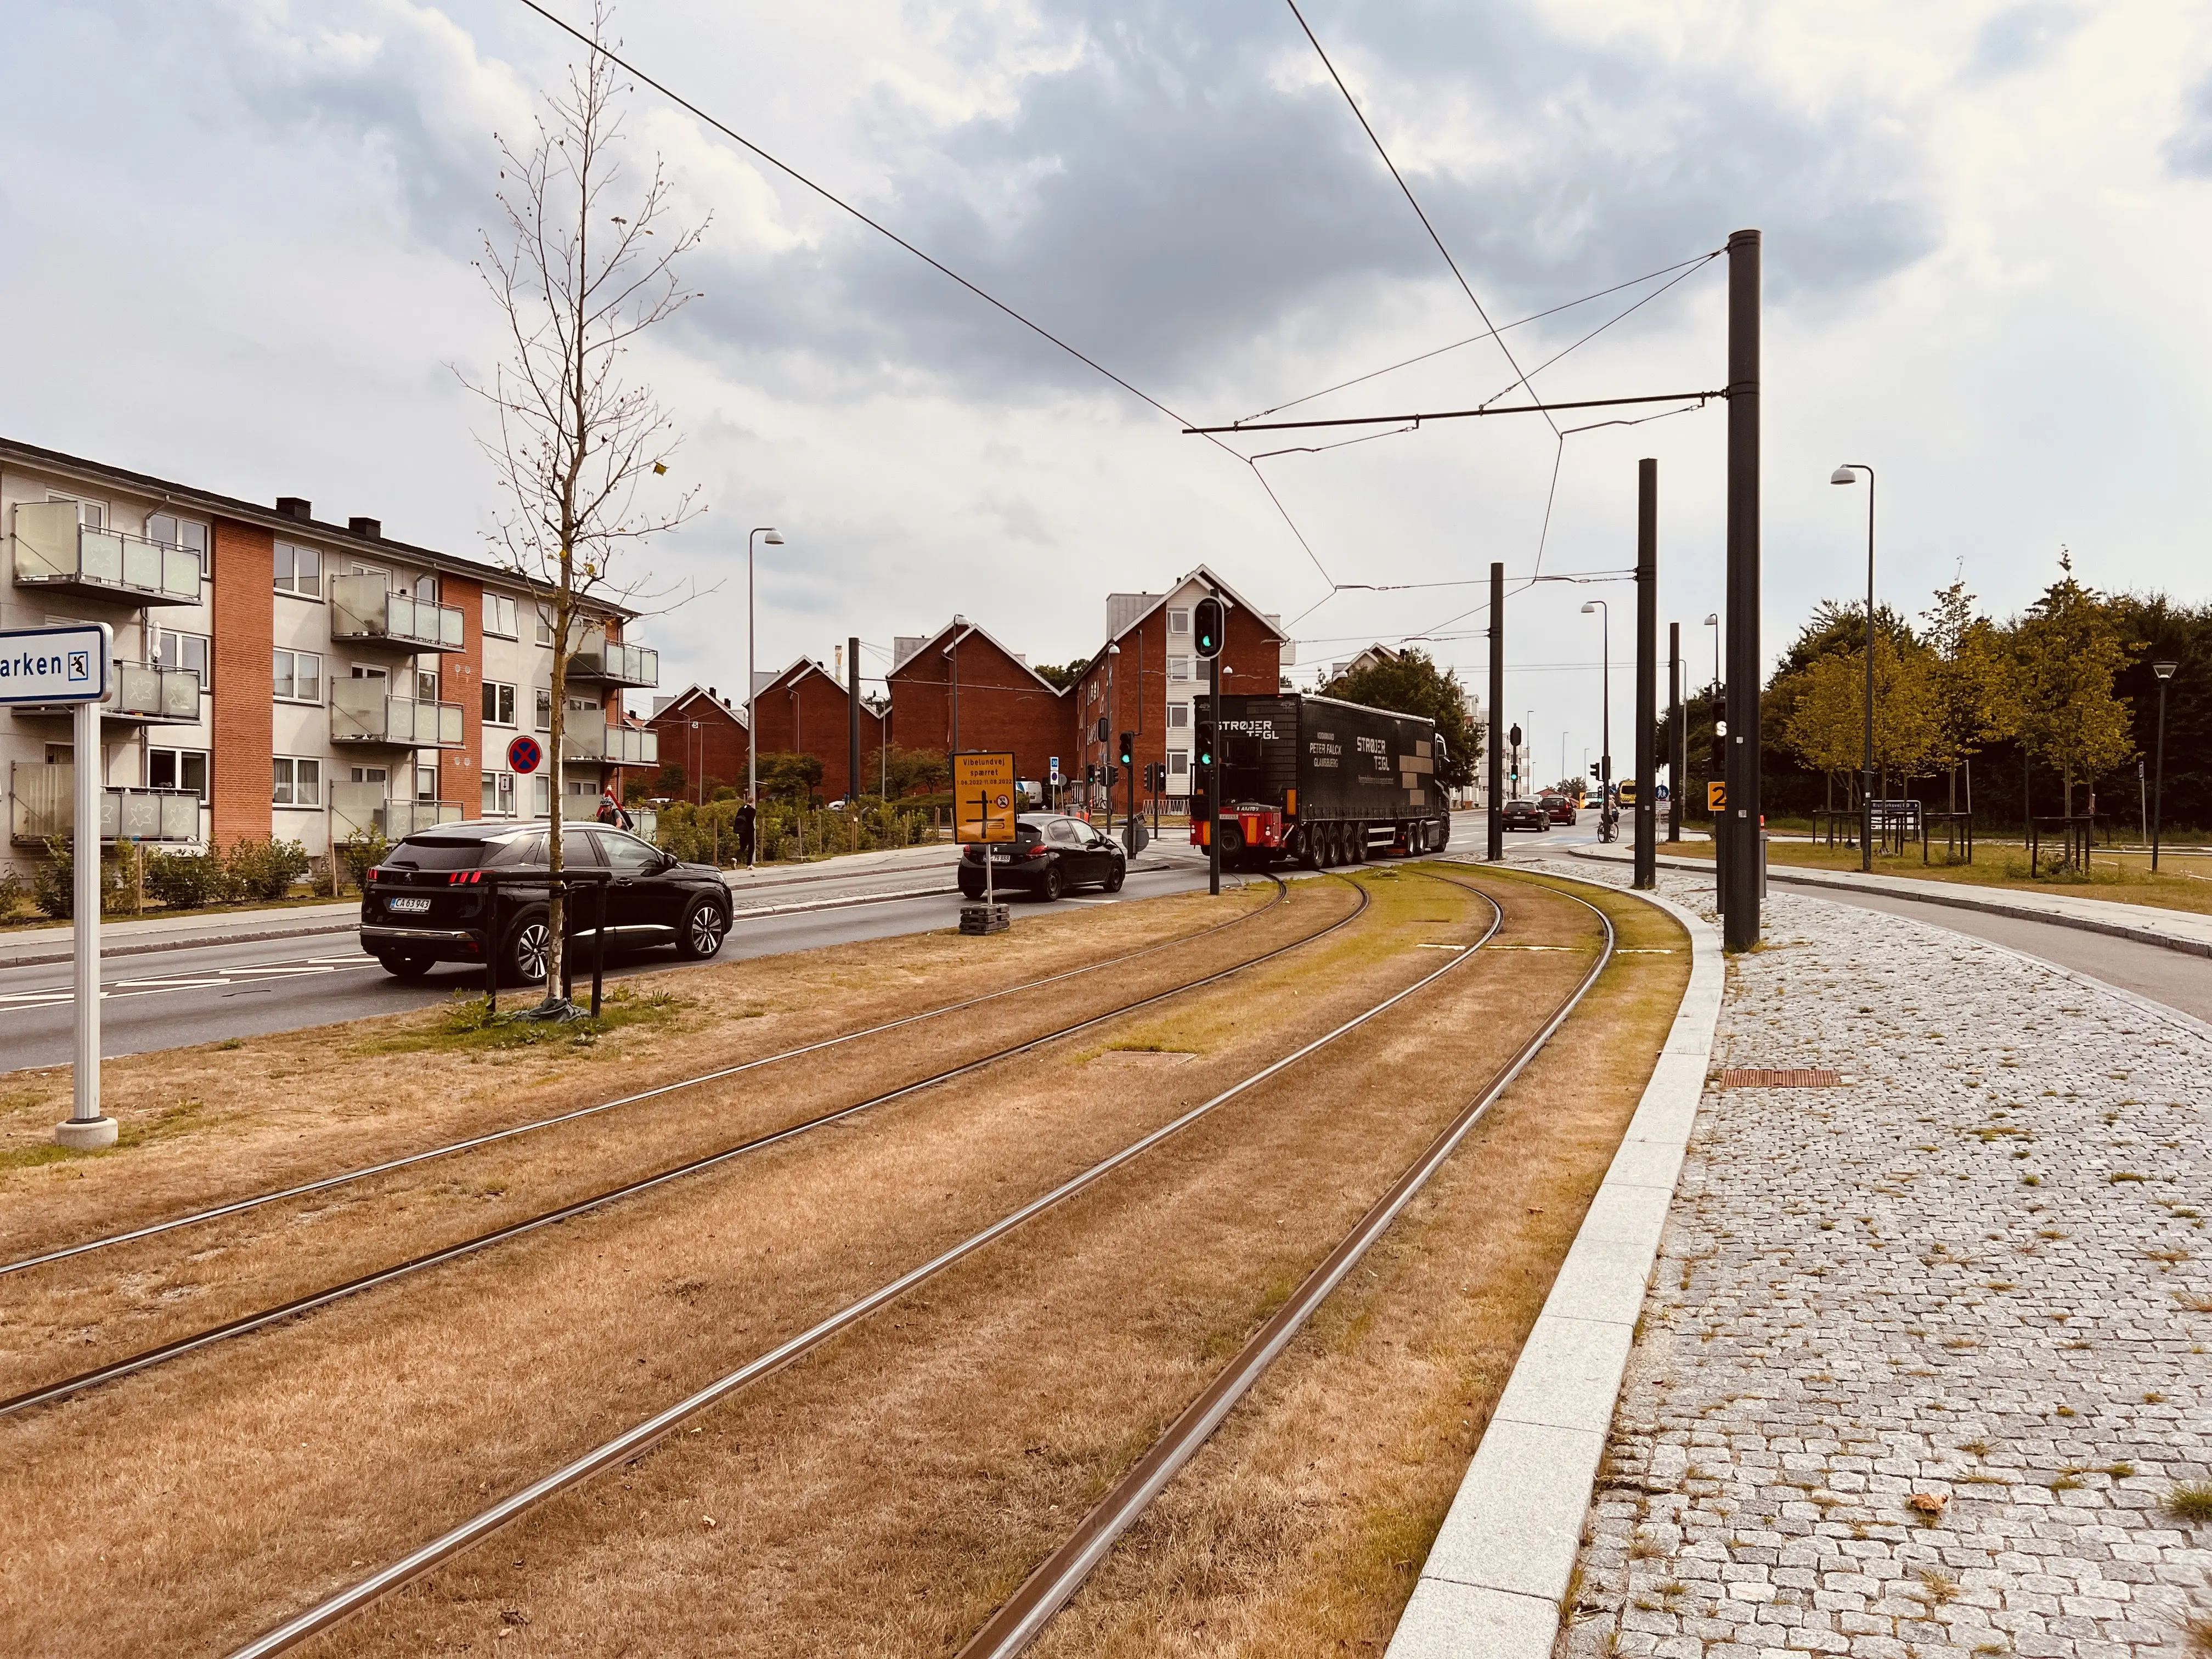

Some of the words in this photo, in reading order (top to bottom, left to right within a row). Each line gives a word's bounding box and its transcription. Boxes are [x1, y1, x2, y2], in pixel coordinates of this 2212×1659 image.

[0, 652, 61, 677] arken
[1246, 730, 1279, 740] TEGL
[1310, 742, 1325, 754] PETER
[1357, 736, 1386, 754] STRØJER
[963, 758, 1005, 766] Vibelundvej
[1374, 755, 1390, 771] TEGL
[970, 769, 998, 777] spærret
[1712, 786, 1726, 806] 2
[396, 899, 405, 907] CA
[406, 899, 415, 907] 63
[416, 900, 429, 909] 943
